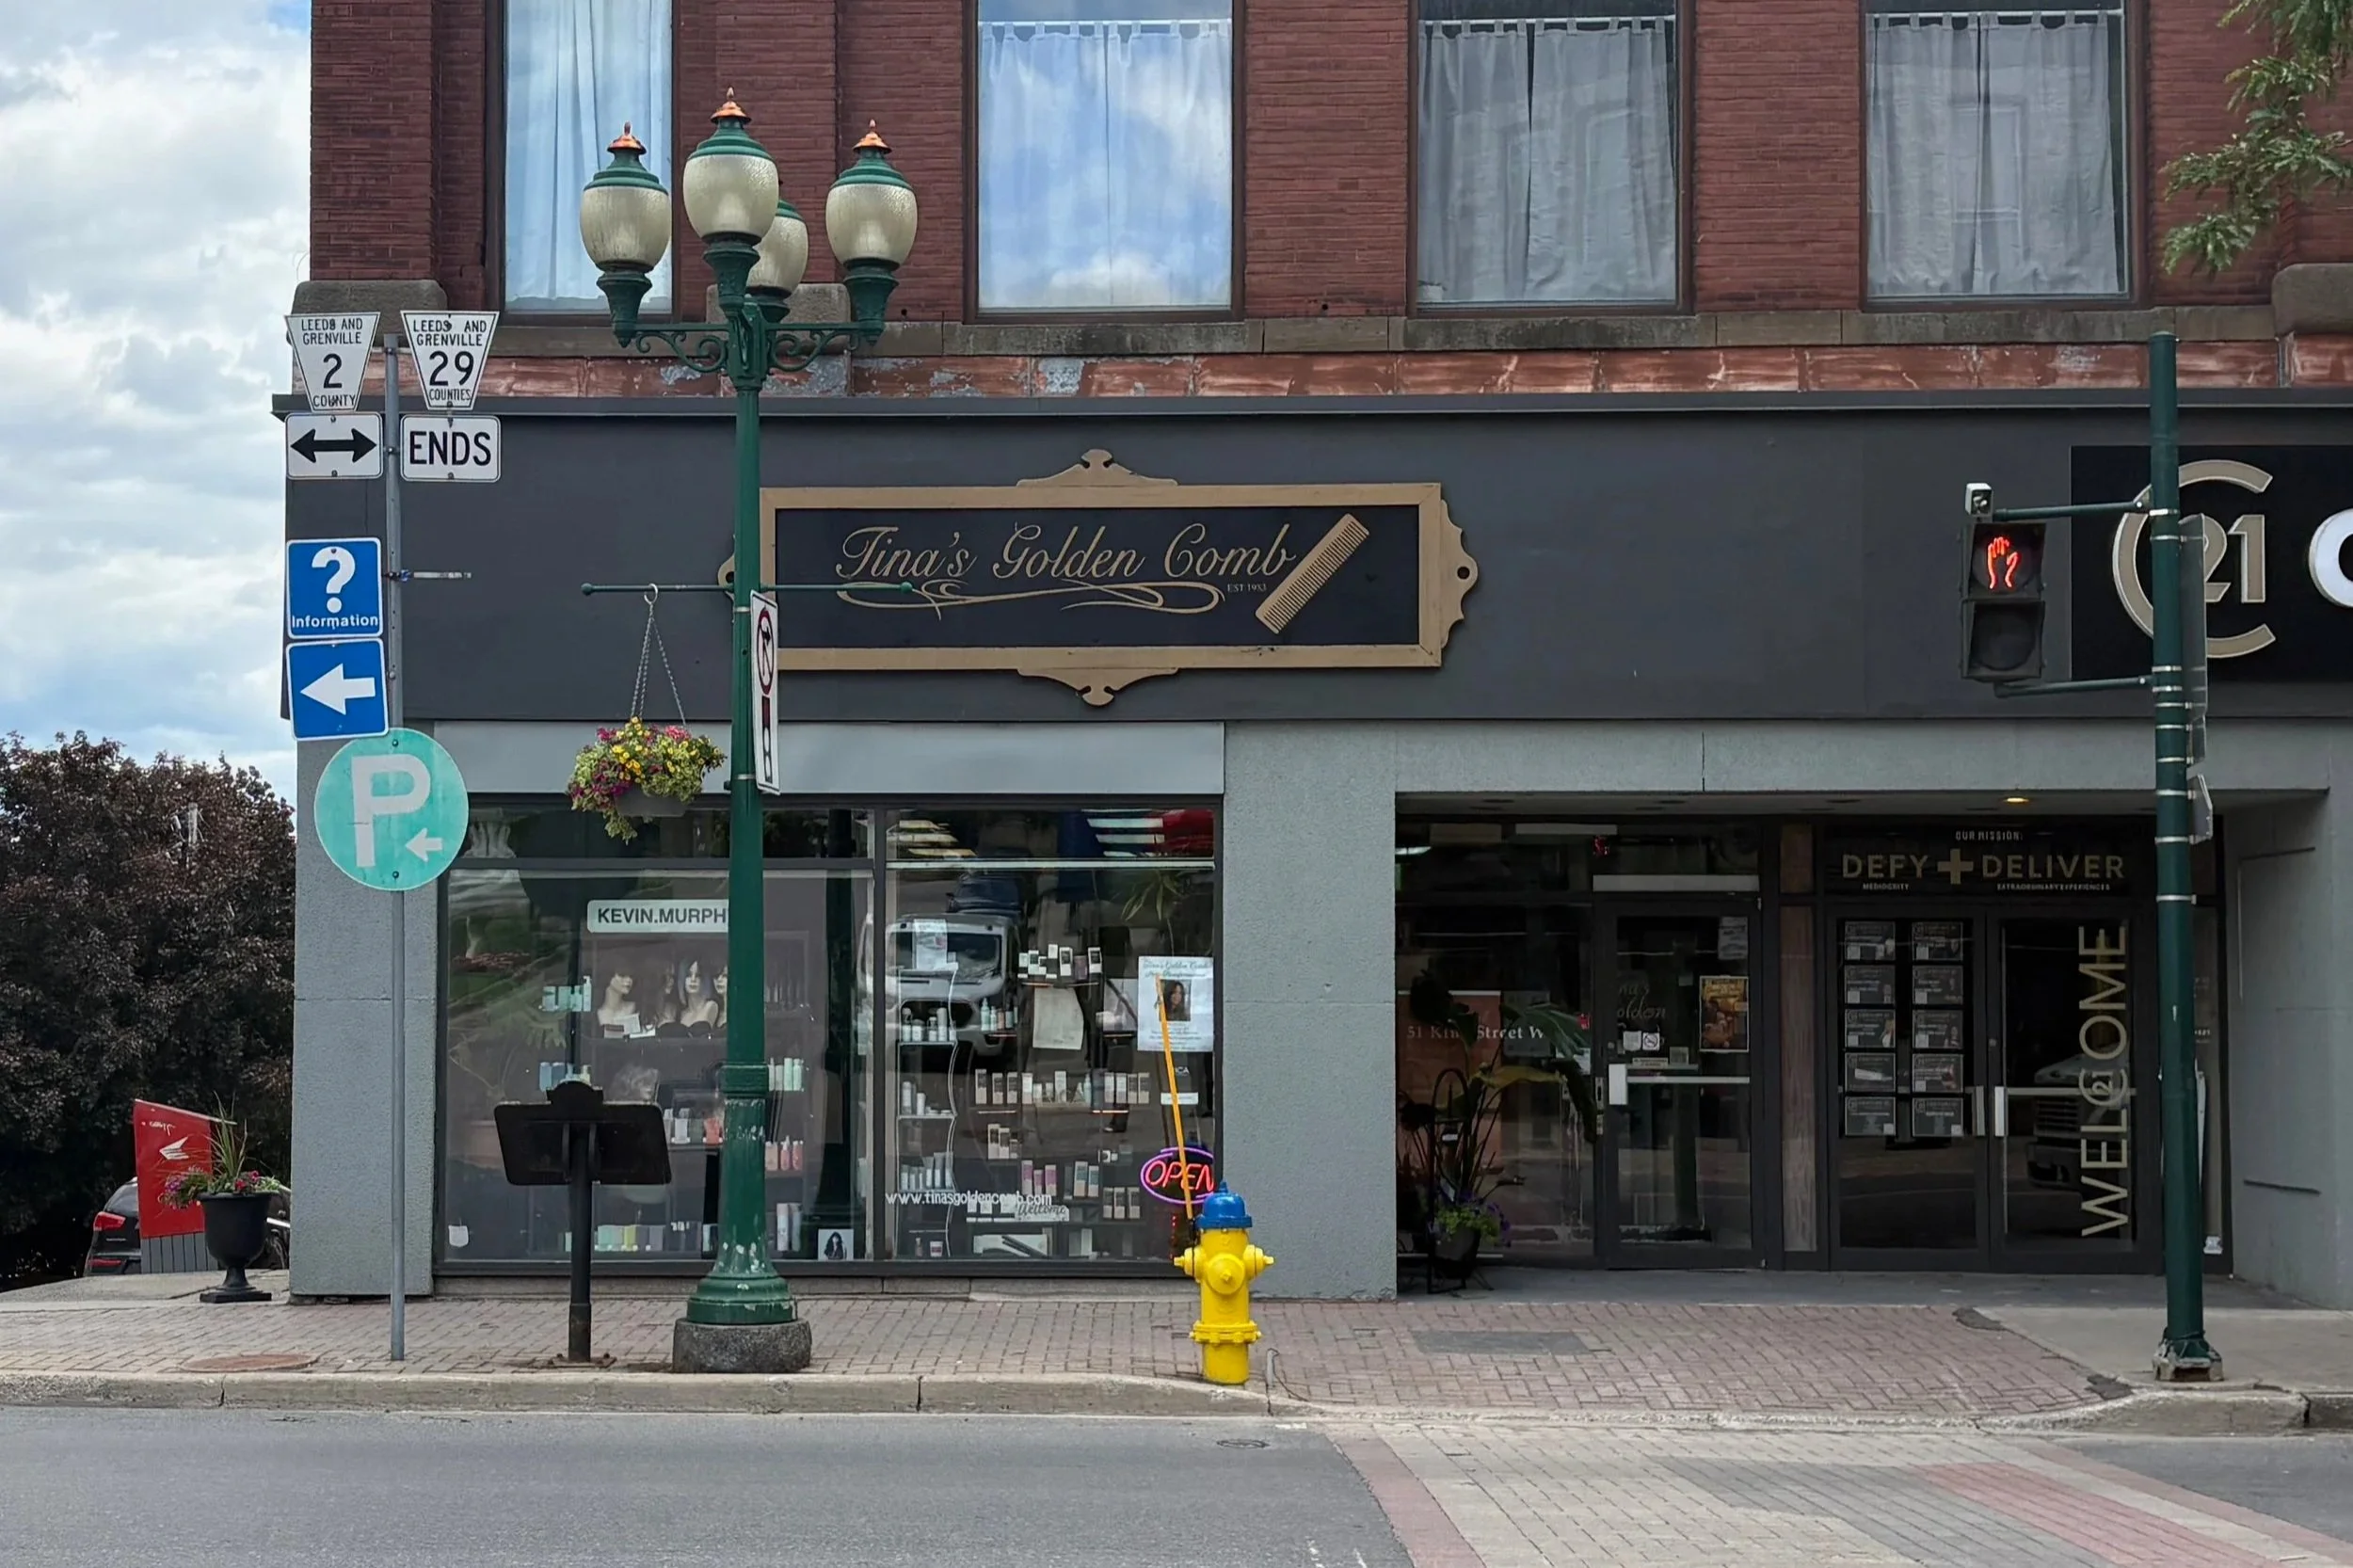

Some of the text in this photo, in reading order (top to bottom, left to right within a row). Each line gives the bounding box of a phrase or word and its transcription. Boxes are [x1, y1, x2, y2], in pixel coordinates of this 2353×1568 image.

[301, 318, 363, 331] LEEDS AND
[413, 320, 487, 332] LEEDS AND
[302, 331, 362, 345] GRENVILLE
[416, 333, 483, 346] GRENVILLE
[323, 353, 343, 389] 2
[428, 350, 474, 387] 29
[312, 394, 356, 408] COUNTY
[429, 389, 471, 401] COUNTIES
[409, 430, 491, 466] ENDS
[836, 520, 1297, 580] Tina's Golden Comb
[292, 614, 378, 629] Information
[350, 754, 431, 868] P
[1955, 830, 1975, 841] OUR
[1842, 854, 1929, 879] DEFY
[1982, 854, 2125, 879] DELIVER
[598, 907, 728, 924] KEVIN.MURPH
[1430, 1025, 1461, 1039] Kin
[2078, 925, 2130, 1238] WELCOME
[1144, 1160, 1214, 1192] OPEN
